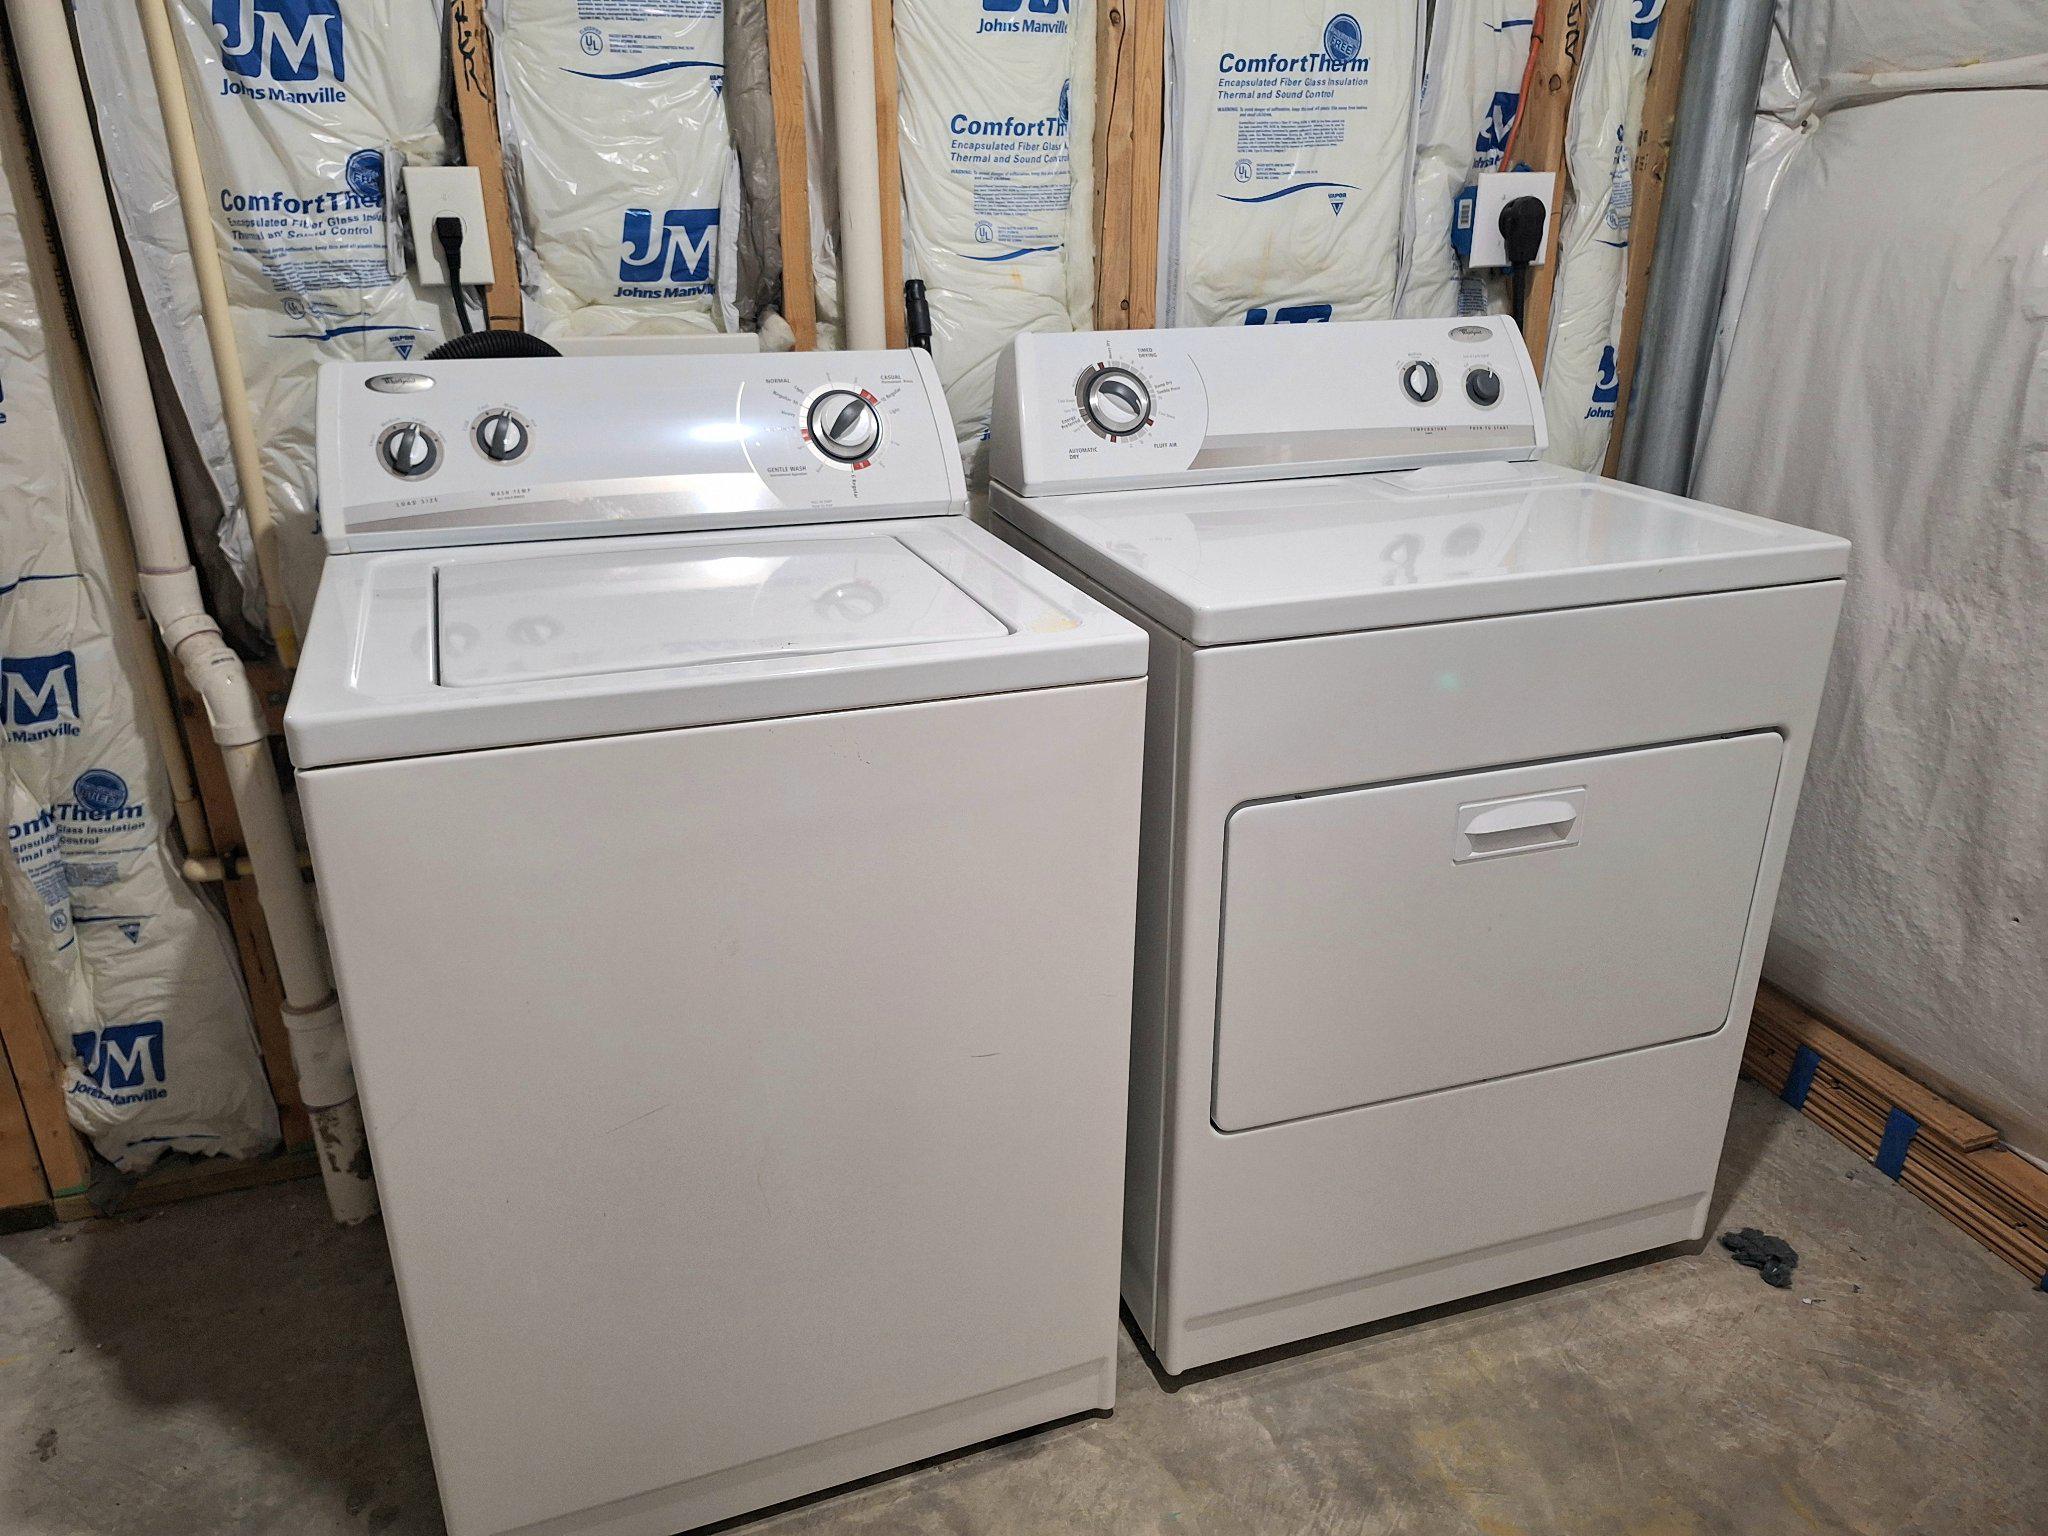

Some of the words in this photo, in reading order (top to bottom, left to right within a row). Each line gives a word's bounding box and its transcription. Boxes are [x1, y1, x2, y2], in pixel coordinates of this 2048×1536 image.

[976, 18, 1020, 34] Johns
[212, 0, 344, 81] JM
[585, 35, 599, 51] UL
[1331, 33, 1352, 56] FREE
[1219, 53, 1369, 73] ComfortTherm
[1218, 78, 1277, 88] Encapsulated
[1280, 78, 1302, 86] Fiber
[1304, 78, 1326, 86] Glass
[1328, 77, 1368, 86] Insulation
[268, 87, 347, 104] Manville
[1218, 90, 1254, 100] Thermal
[1256, 90, 1272, 99] and
[1276, 90, 1303, 98] Sound
[1305, 90, 1334, 98] Control
[951, 140, 1019, 151] Encapsulated
[1018, 142, 1040, 150] Fiber
[950, 152, 990, 163] Thermal
[993, 154, 1010, 163] and
[1014, 154, 1042, 164] Sound
[1239, 166, 1249, 178] UL
[331, 226, 372, 236] Control
[980, 228, 990, 240] UL
[620, 209, 720, 282] JM
[614, 287, 661, 298] Johns
[12, 723, 80, 743] Manville
